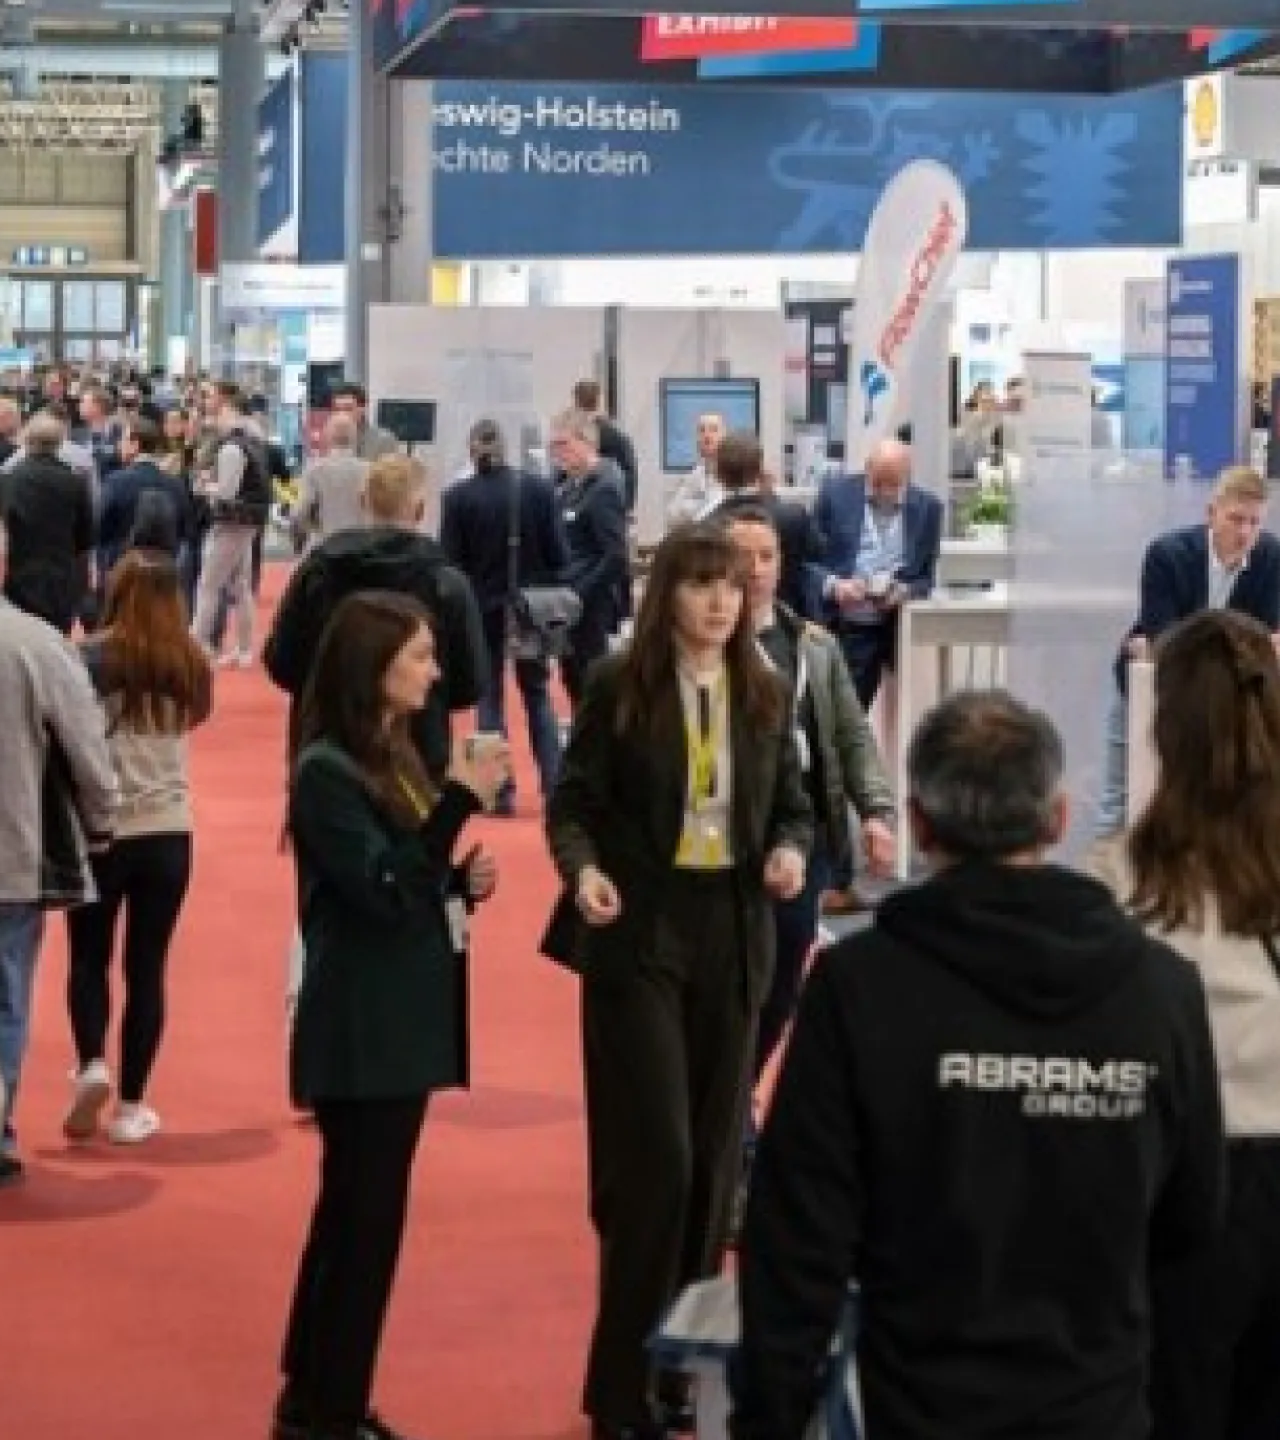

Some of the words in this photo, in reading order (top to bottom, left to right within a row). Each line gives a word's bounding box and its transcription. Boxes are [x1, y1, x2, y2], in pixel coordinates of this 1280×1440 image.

[432, 97, 680, 135] swig-Holstein
[434, 139, 510, 173] chte
[522, 141, 649, 175] Norden
